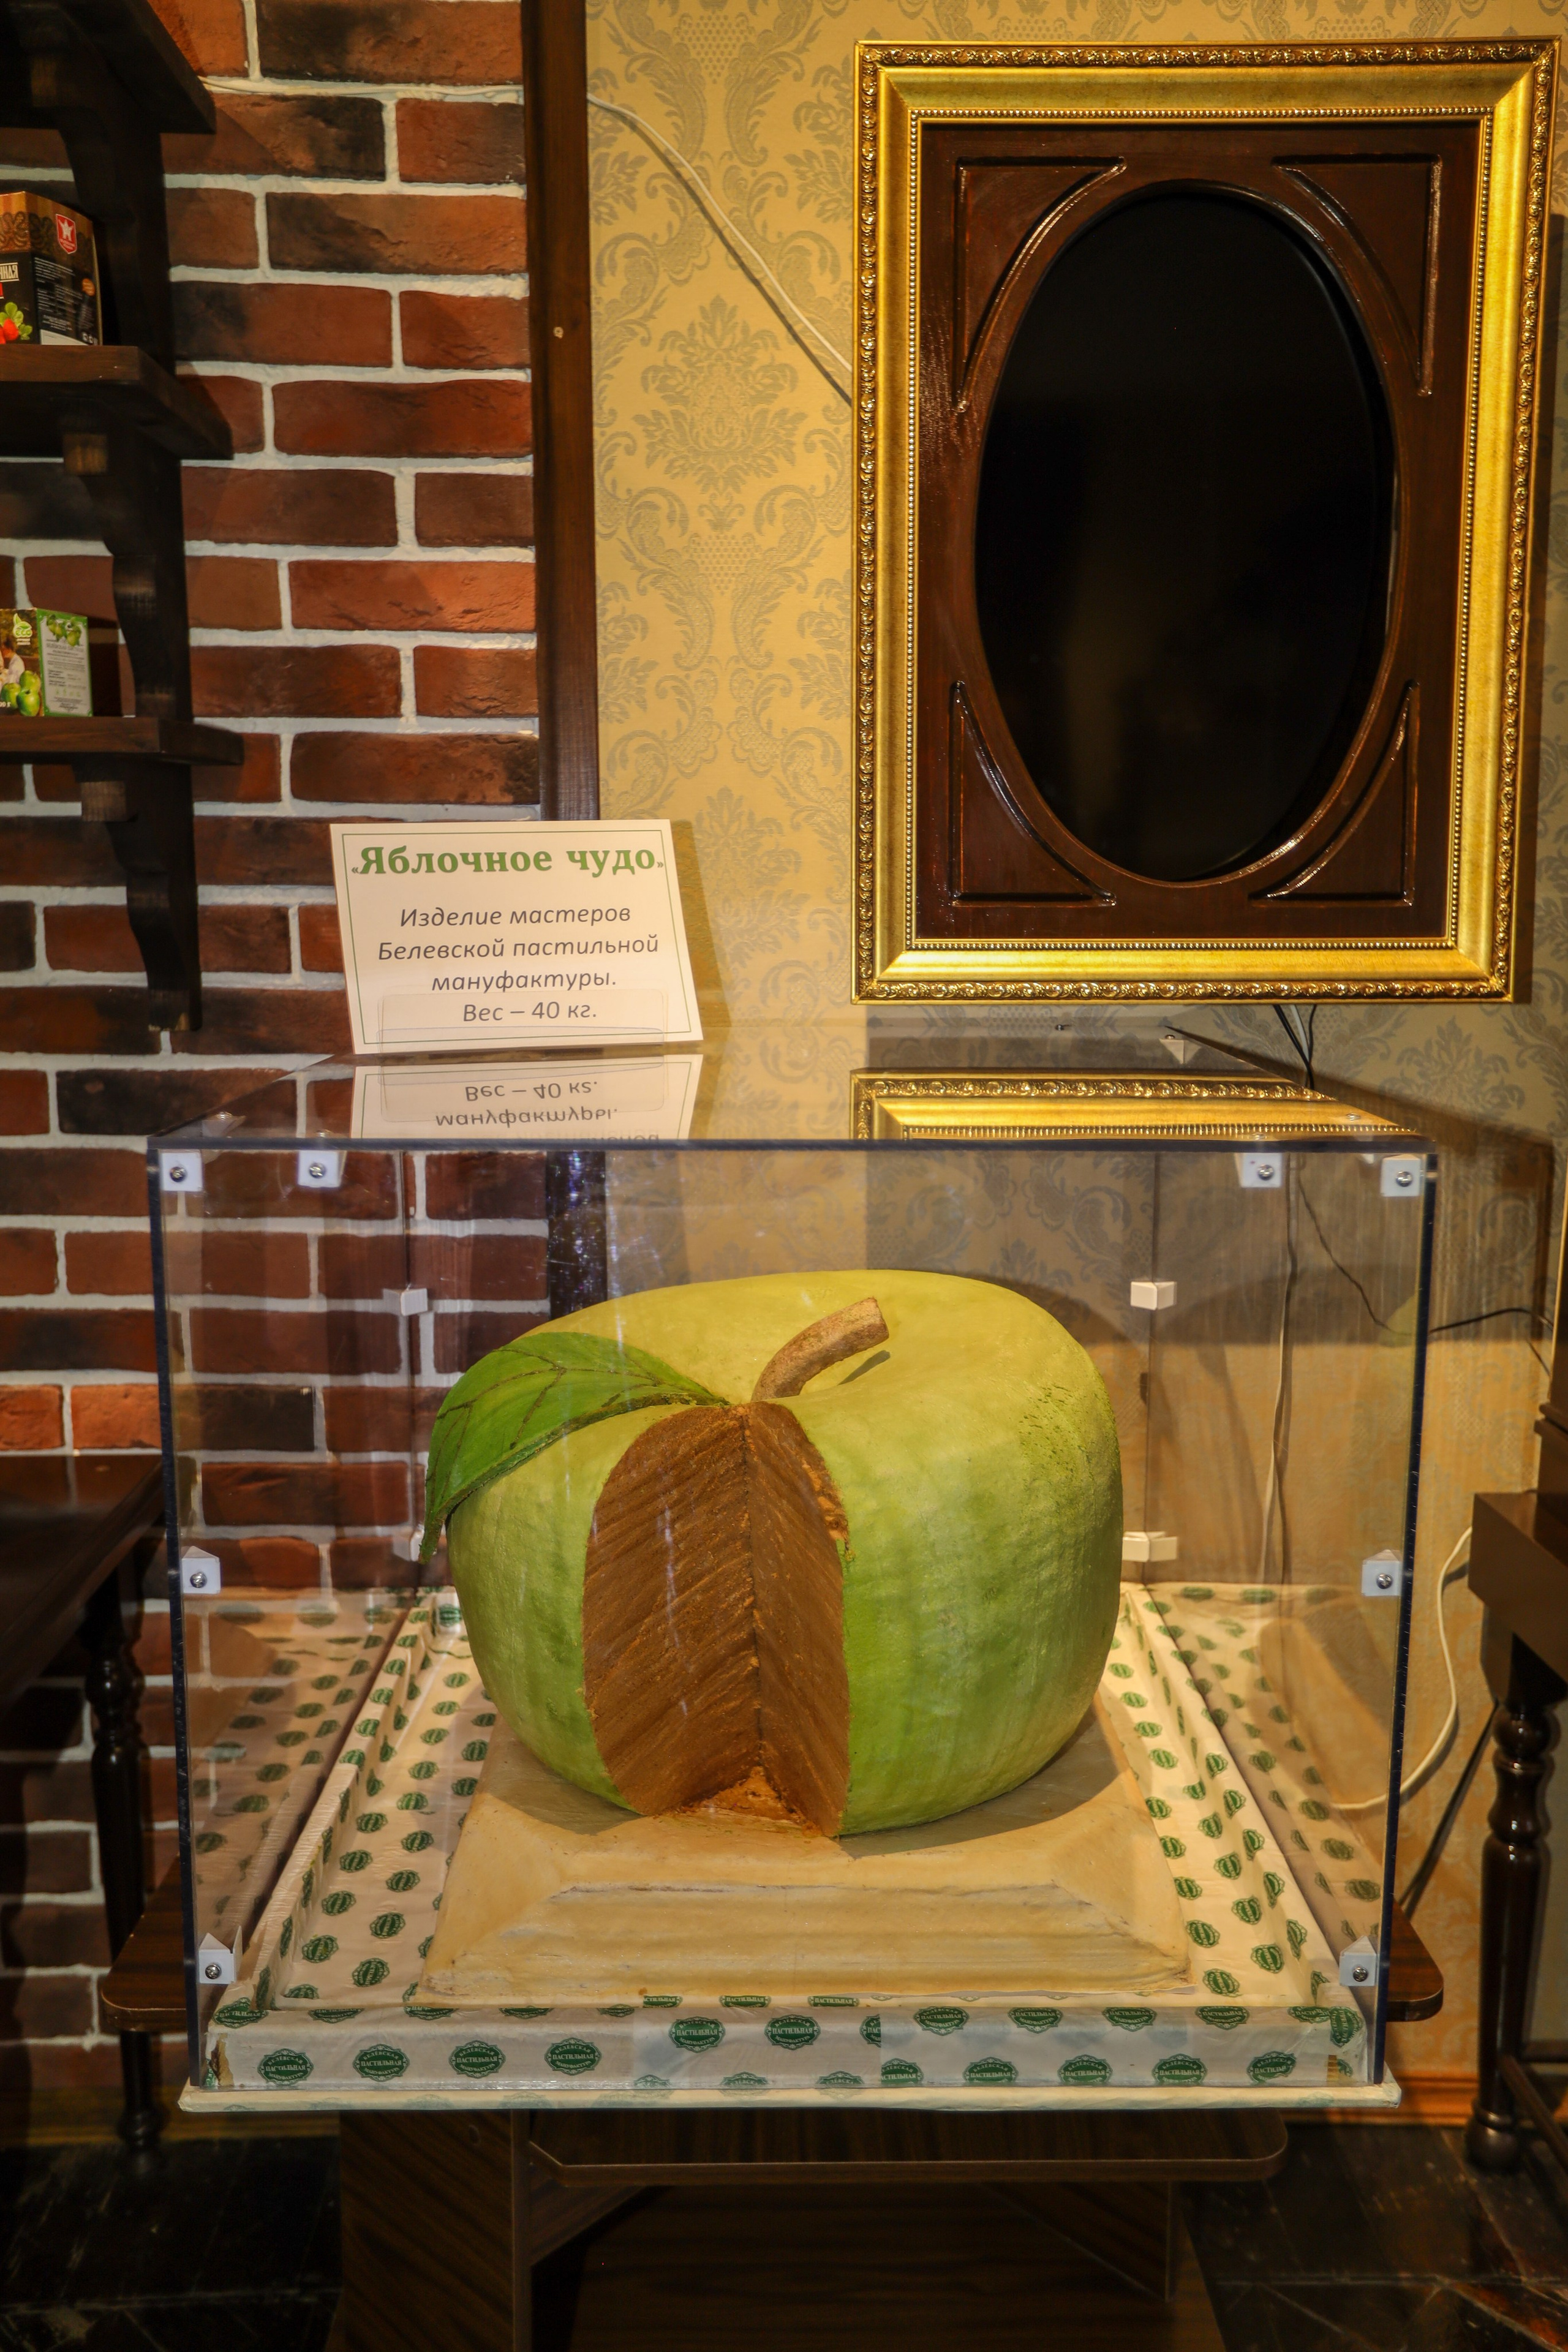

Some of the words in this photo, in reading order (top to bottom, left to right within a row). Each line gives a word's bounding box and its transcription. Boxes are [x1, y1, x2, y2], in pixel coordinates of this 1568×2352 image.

[351, 845, 552, 875] «Яблочное
[566, 848, 664, 878] чудо»
[401, 907, 502, 927] Изделие
[510, 908, 630, 926] мастеров
[379, 938, 504, 960] Белевской
[513, 934, 658, 956] пастильной
[432, 970, 616, 993] мануфактуры.
[464, 1005, 503, 1022] Вес
[532, 1001, 559, 1019] 40
[568, 1005, 596, 1018] кг.
